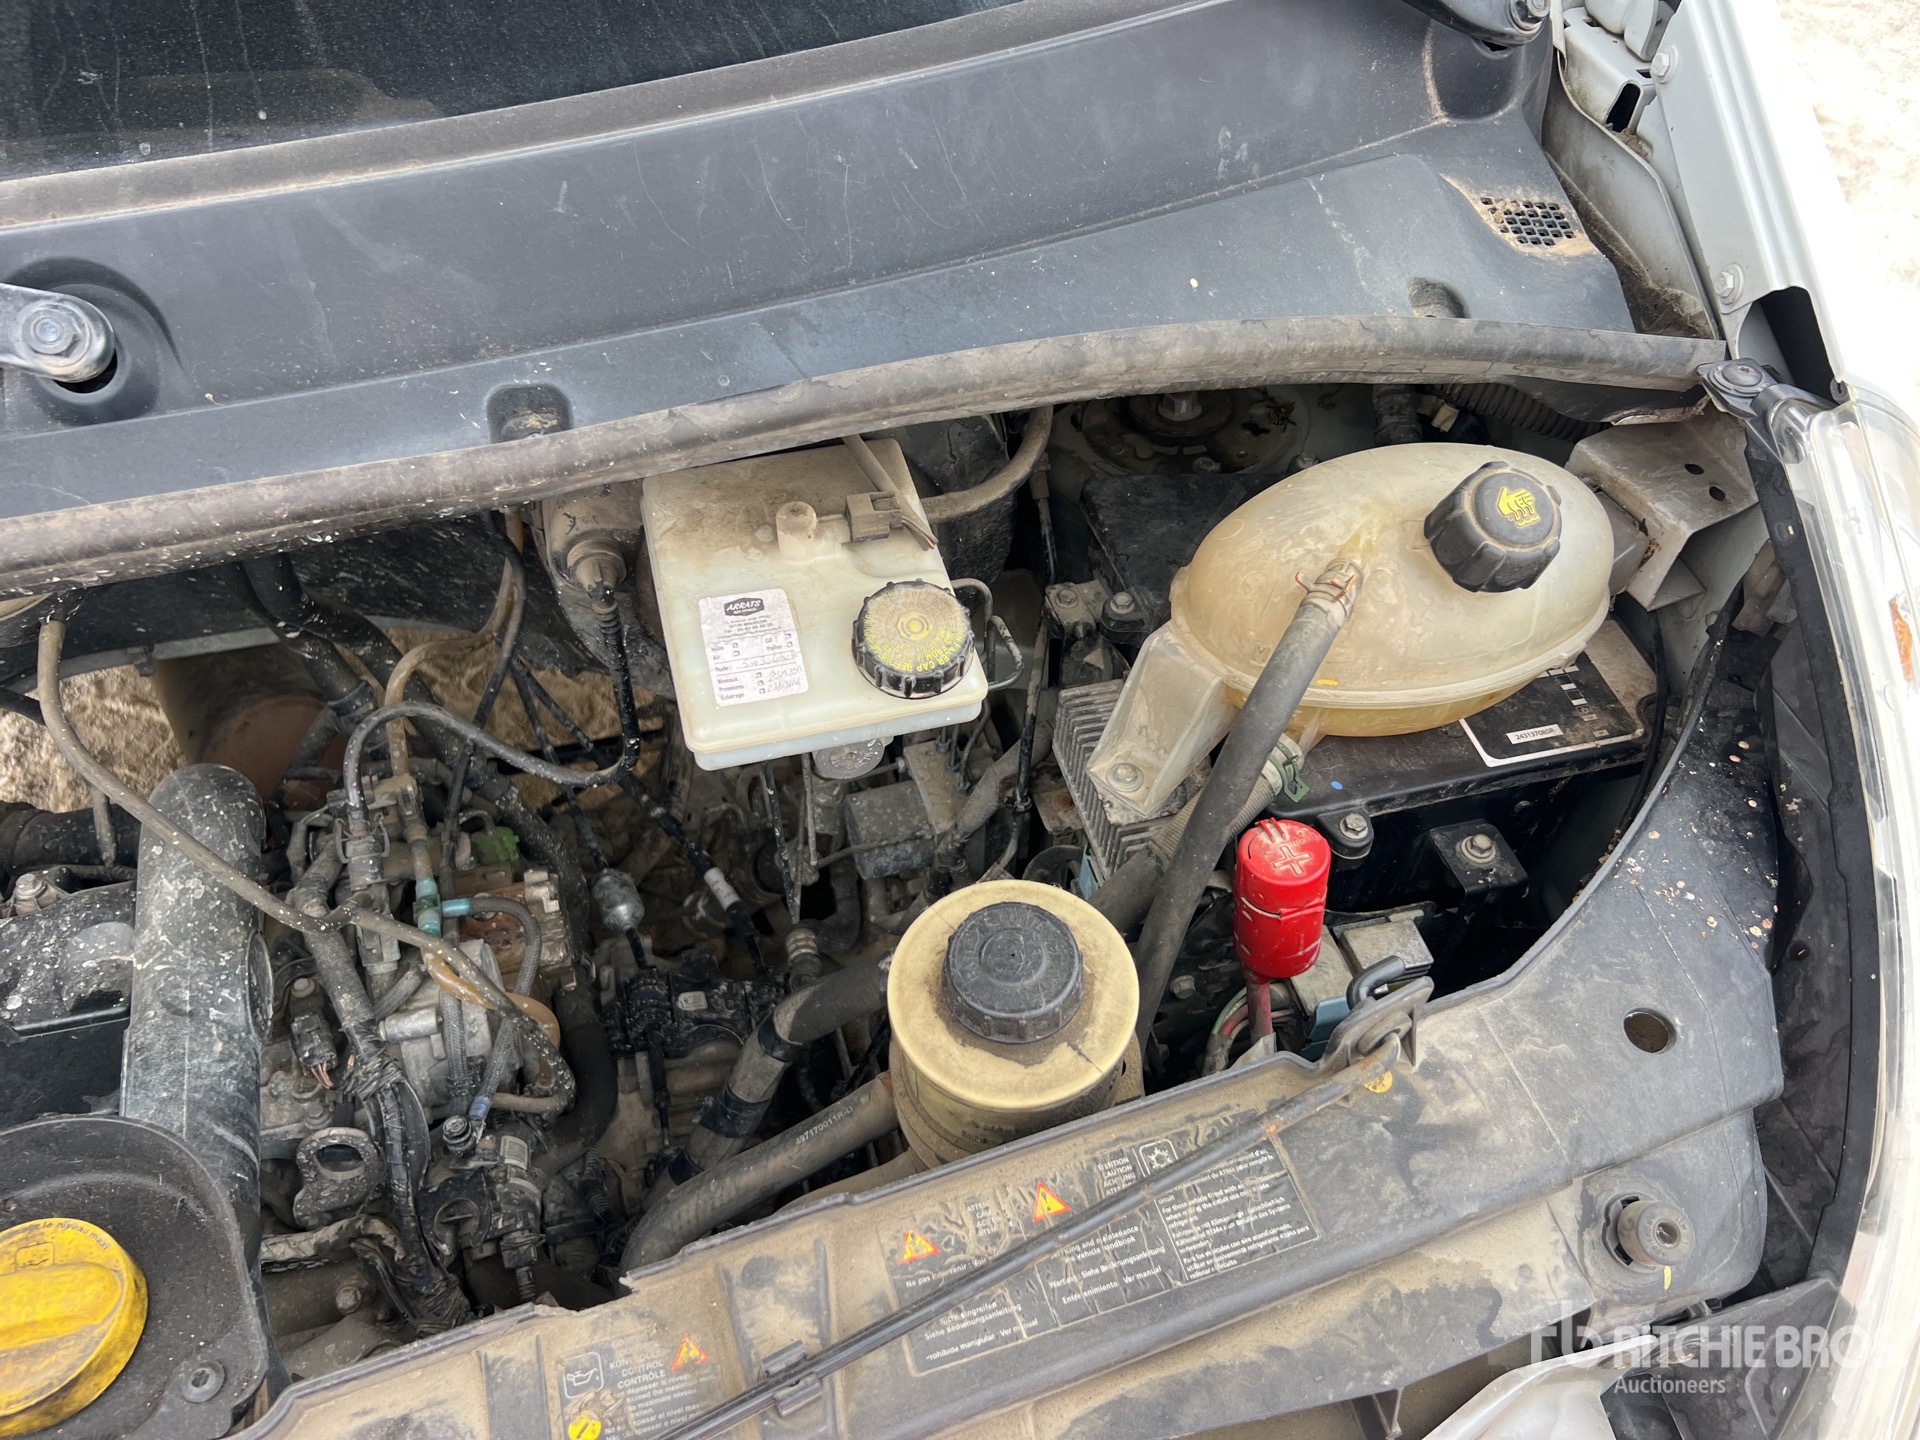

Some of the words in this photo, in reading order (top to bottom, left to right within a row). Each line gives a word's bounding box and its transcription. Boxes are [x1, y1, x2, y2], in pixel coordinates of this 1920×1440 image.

[725, 599, 762, 611] ARRATS
[916, 660, 936, 672] CAP
[719, 684, 744, 692] Pressions
[1223, 1185, 1236, 1193] with
[89, 1231, 110, 1250] maxi
[1081, 1239, 1094, 1248] and
[1077, 1246, 1100, 1259] vehicle
[906, 1279, 916, 1287] Ne
[917, 1275, 930, 1285] pas
[1062, 1279, 1117, 1304] Entreenimiento
[1123, 1274, 1135, 1283] Ver
[999, 1327, 1011, 1336] Ver
[1012, 1318, 1038, 1332] mnual
[666, 1407, 683, 1416] nivel
